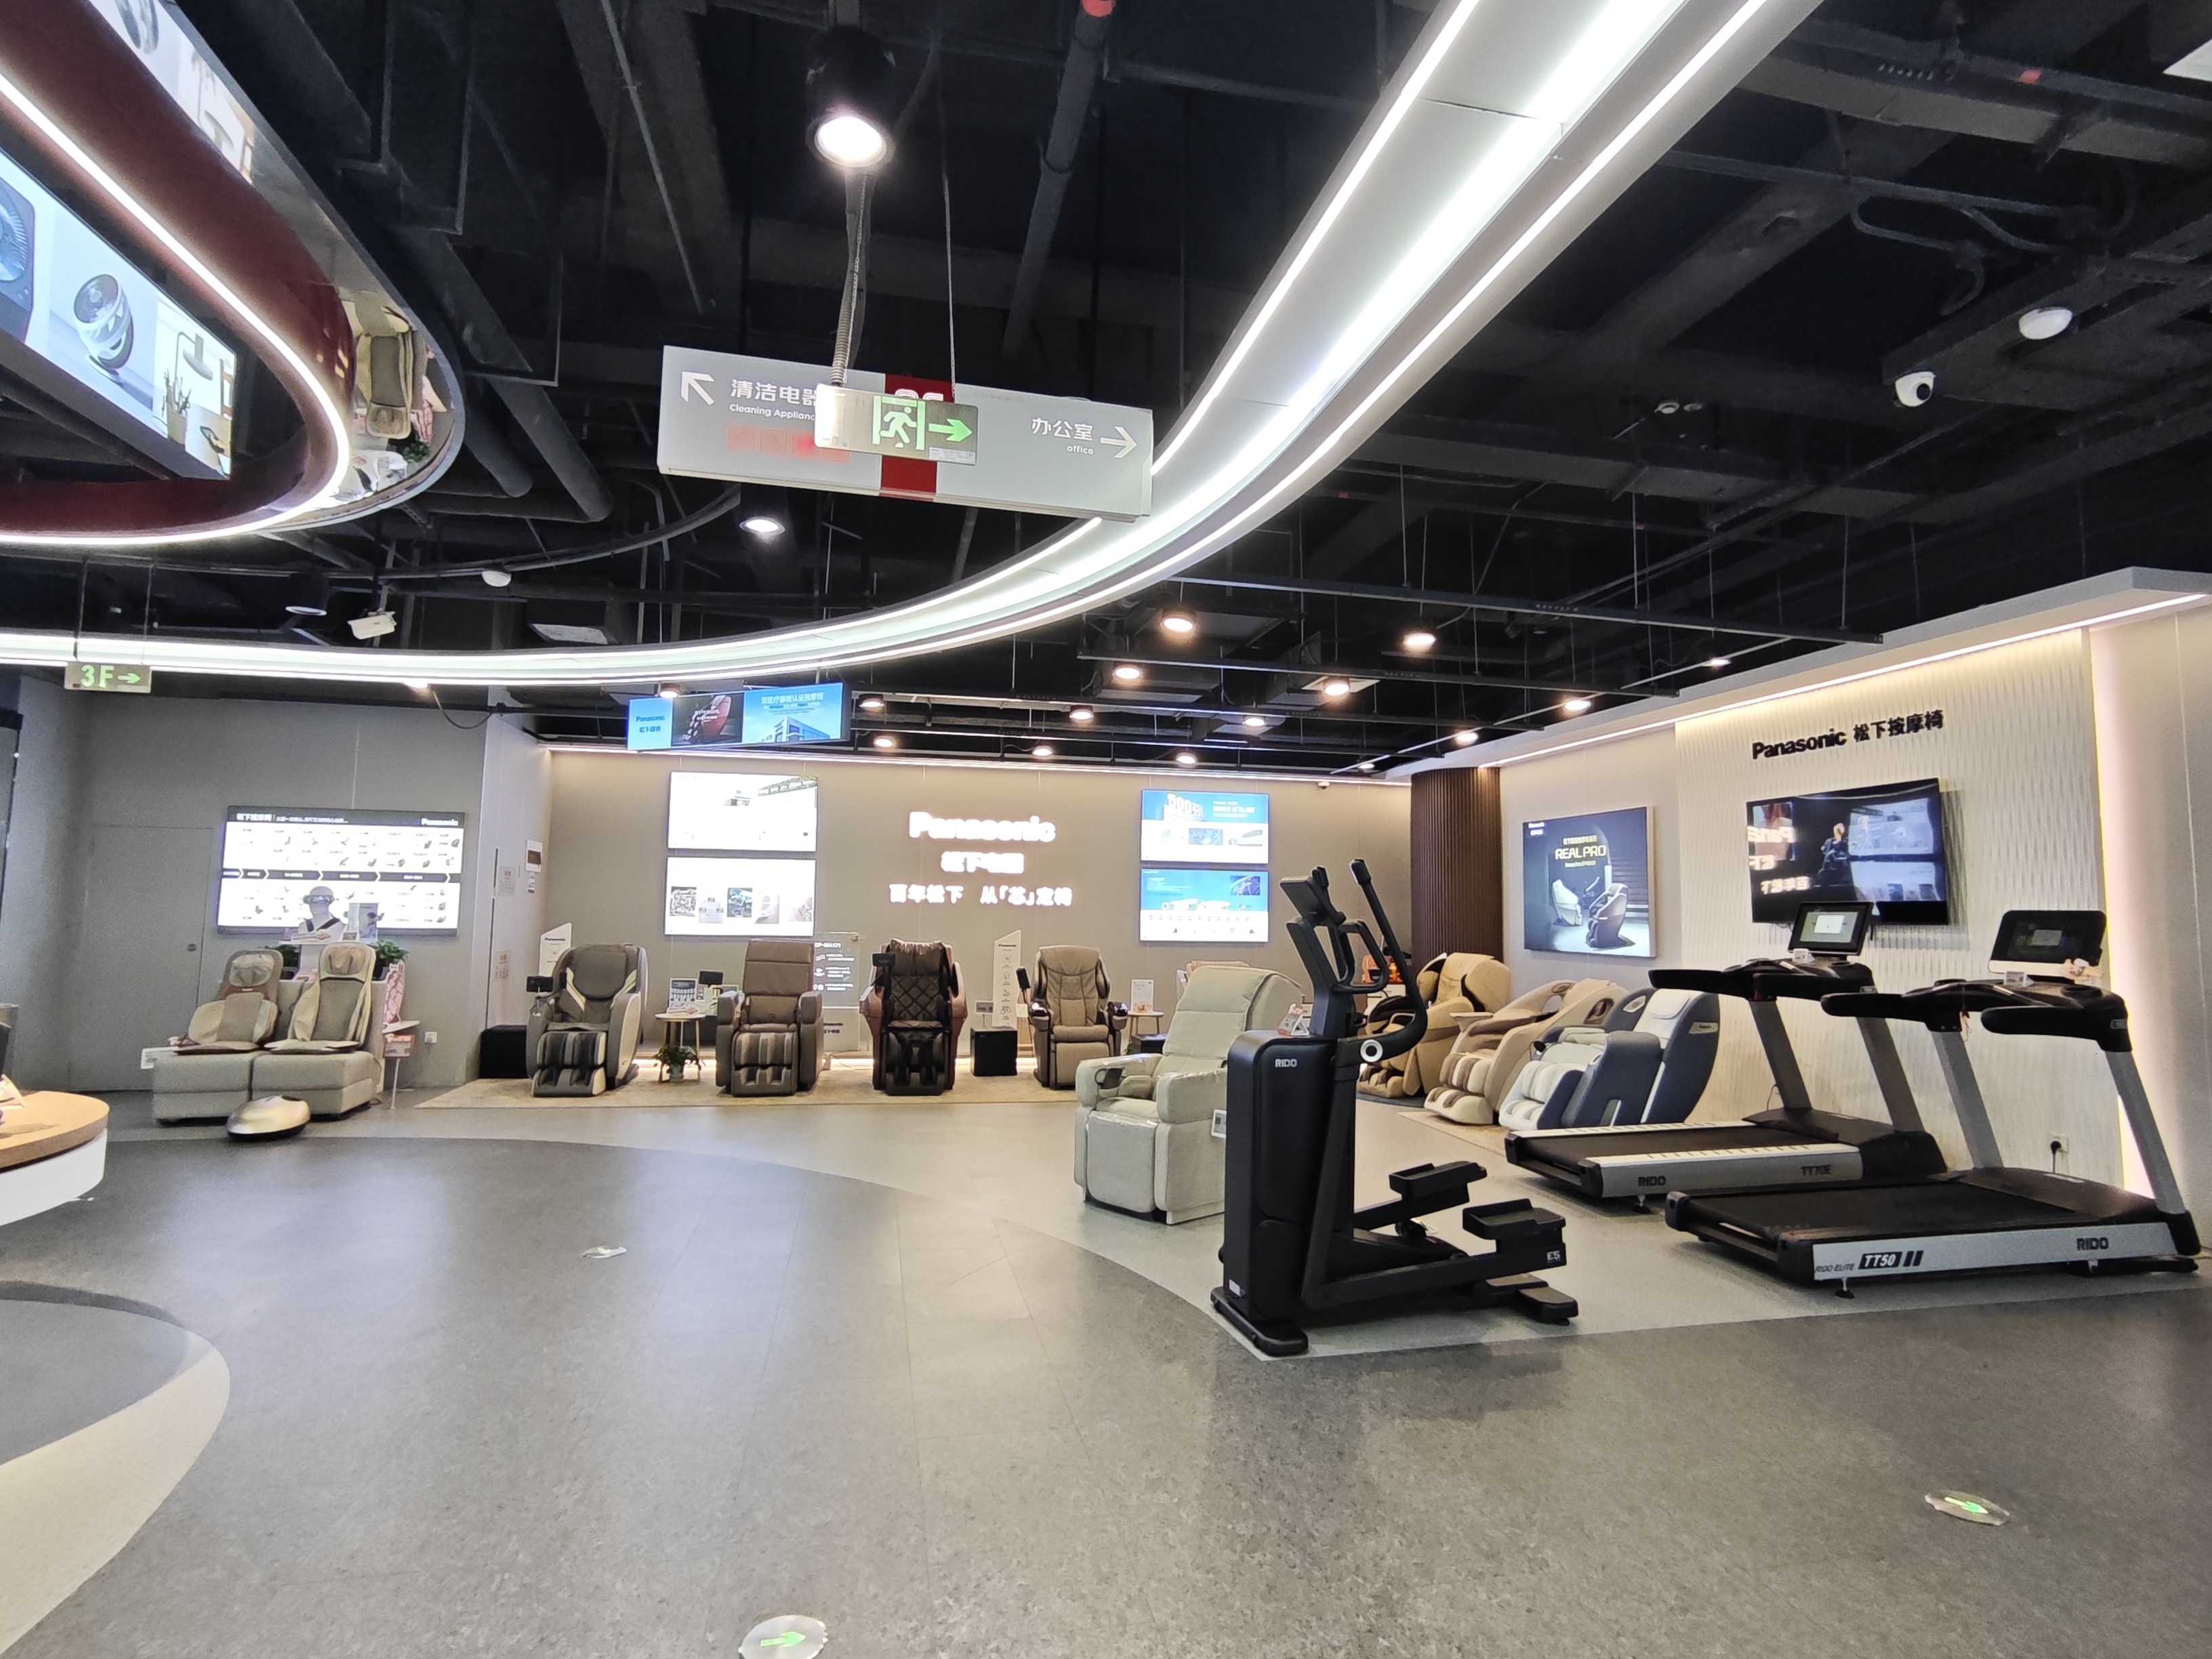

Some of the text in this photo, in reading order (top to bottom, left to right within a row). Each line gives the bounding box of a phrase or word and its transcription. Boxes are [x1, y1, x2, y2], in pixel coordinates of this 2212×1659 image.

[729, 403, 815, 421] Cleaning Applianc
[1031, 417, 1093, 441] 办公室
[1067, 445, 1093, 455] office
[81, 664, 115, 687] 3F
[1752, 710, 1944, 760] Panasonic 松下按摩椅
[909, 811, 1056, 842] Panasonic
[1555, 844, 1607, 860] REAL PRO
[1275, 1059, 1298, 1068] RIDO
[1638, 1175, 1666, 1187] RIDO
[2076, 1237, 2109, 1250] RIDO
[1547, 1250, 1561, 1261] E5
[1834, 1263, 1856, 1272] ELITE
[1864, 1254, 1896, 1267] TT50
